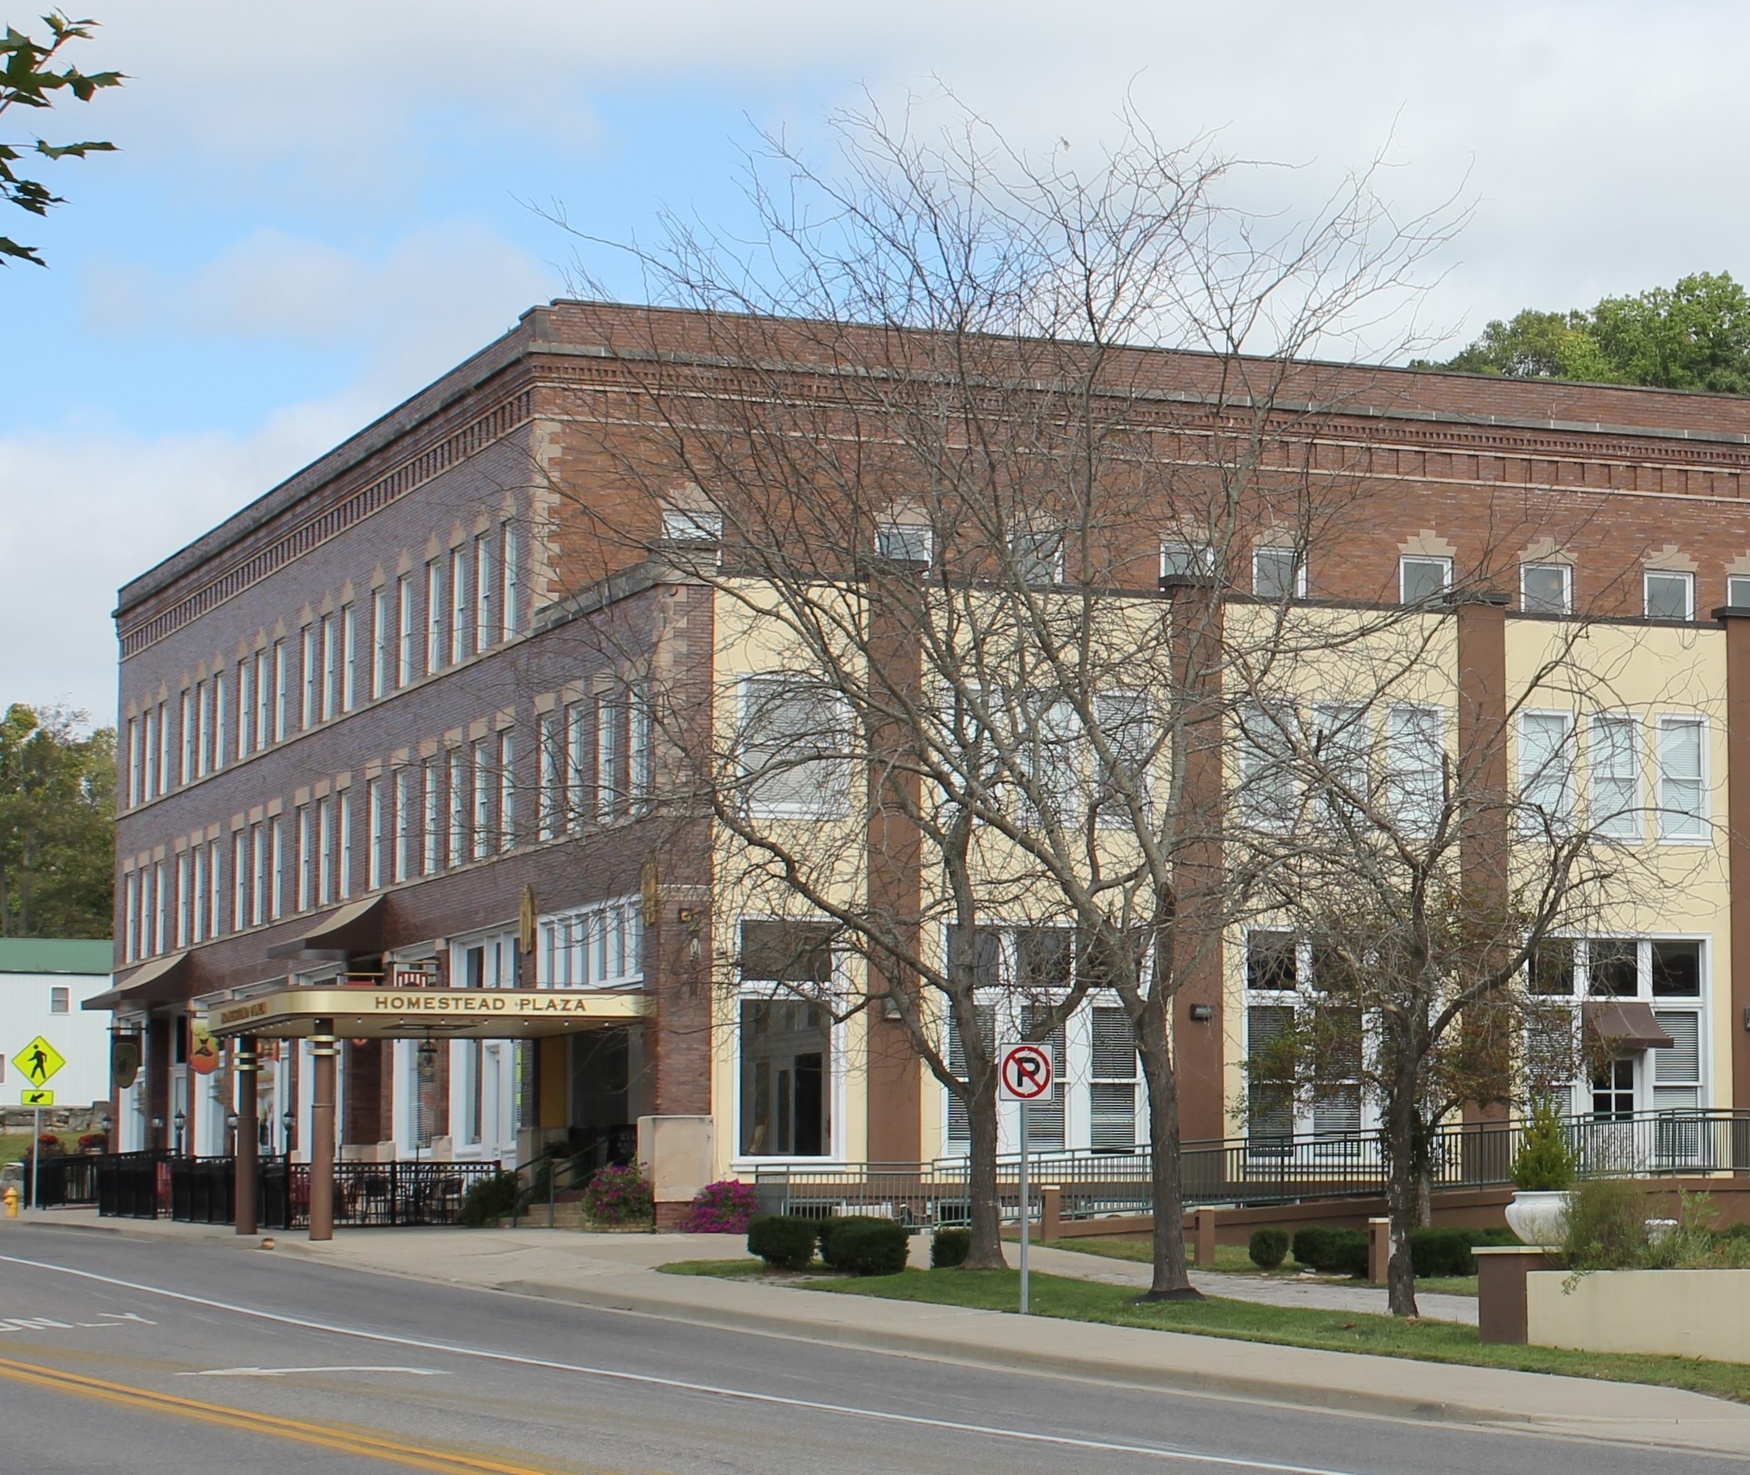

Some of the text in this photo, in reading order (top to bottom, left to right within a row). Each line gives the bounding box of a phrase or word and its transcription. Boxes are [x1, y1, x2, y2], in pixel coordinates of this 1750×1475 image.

[374, 996, 587, 1011] HOMESTEAD PLAZA
[1017, 1057, 1041, 1087] P
